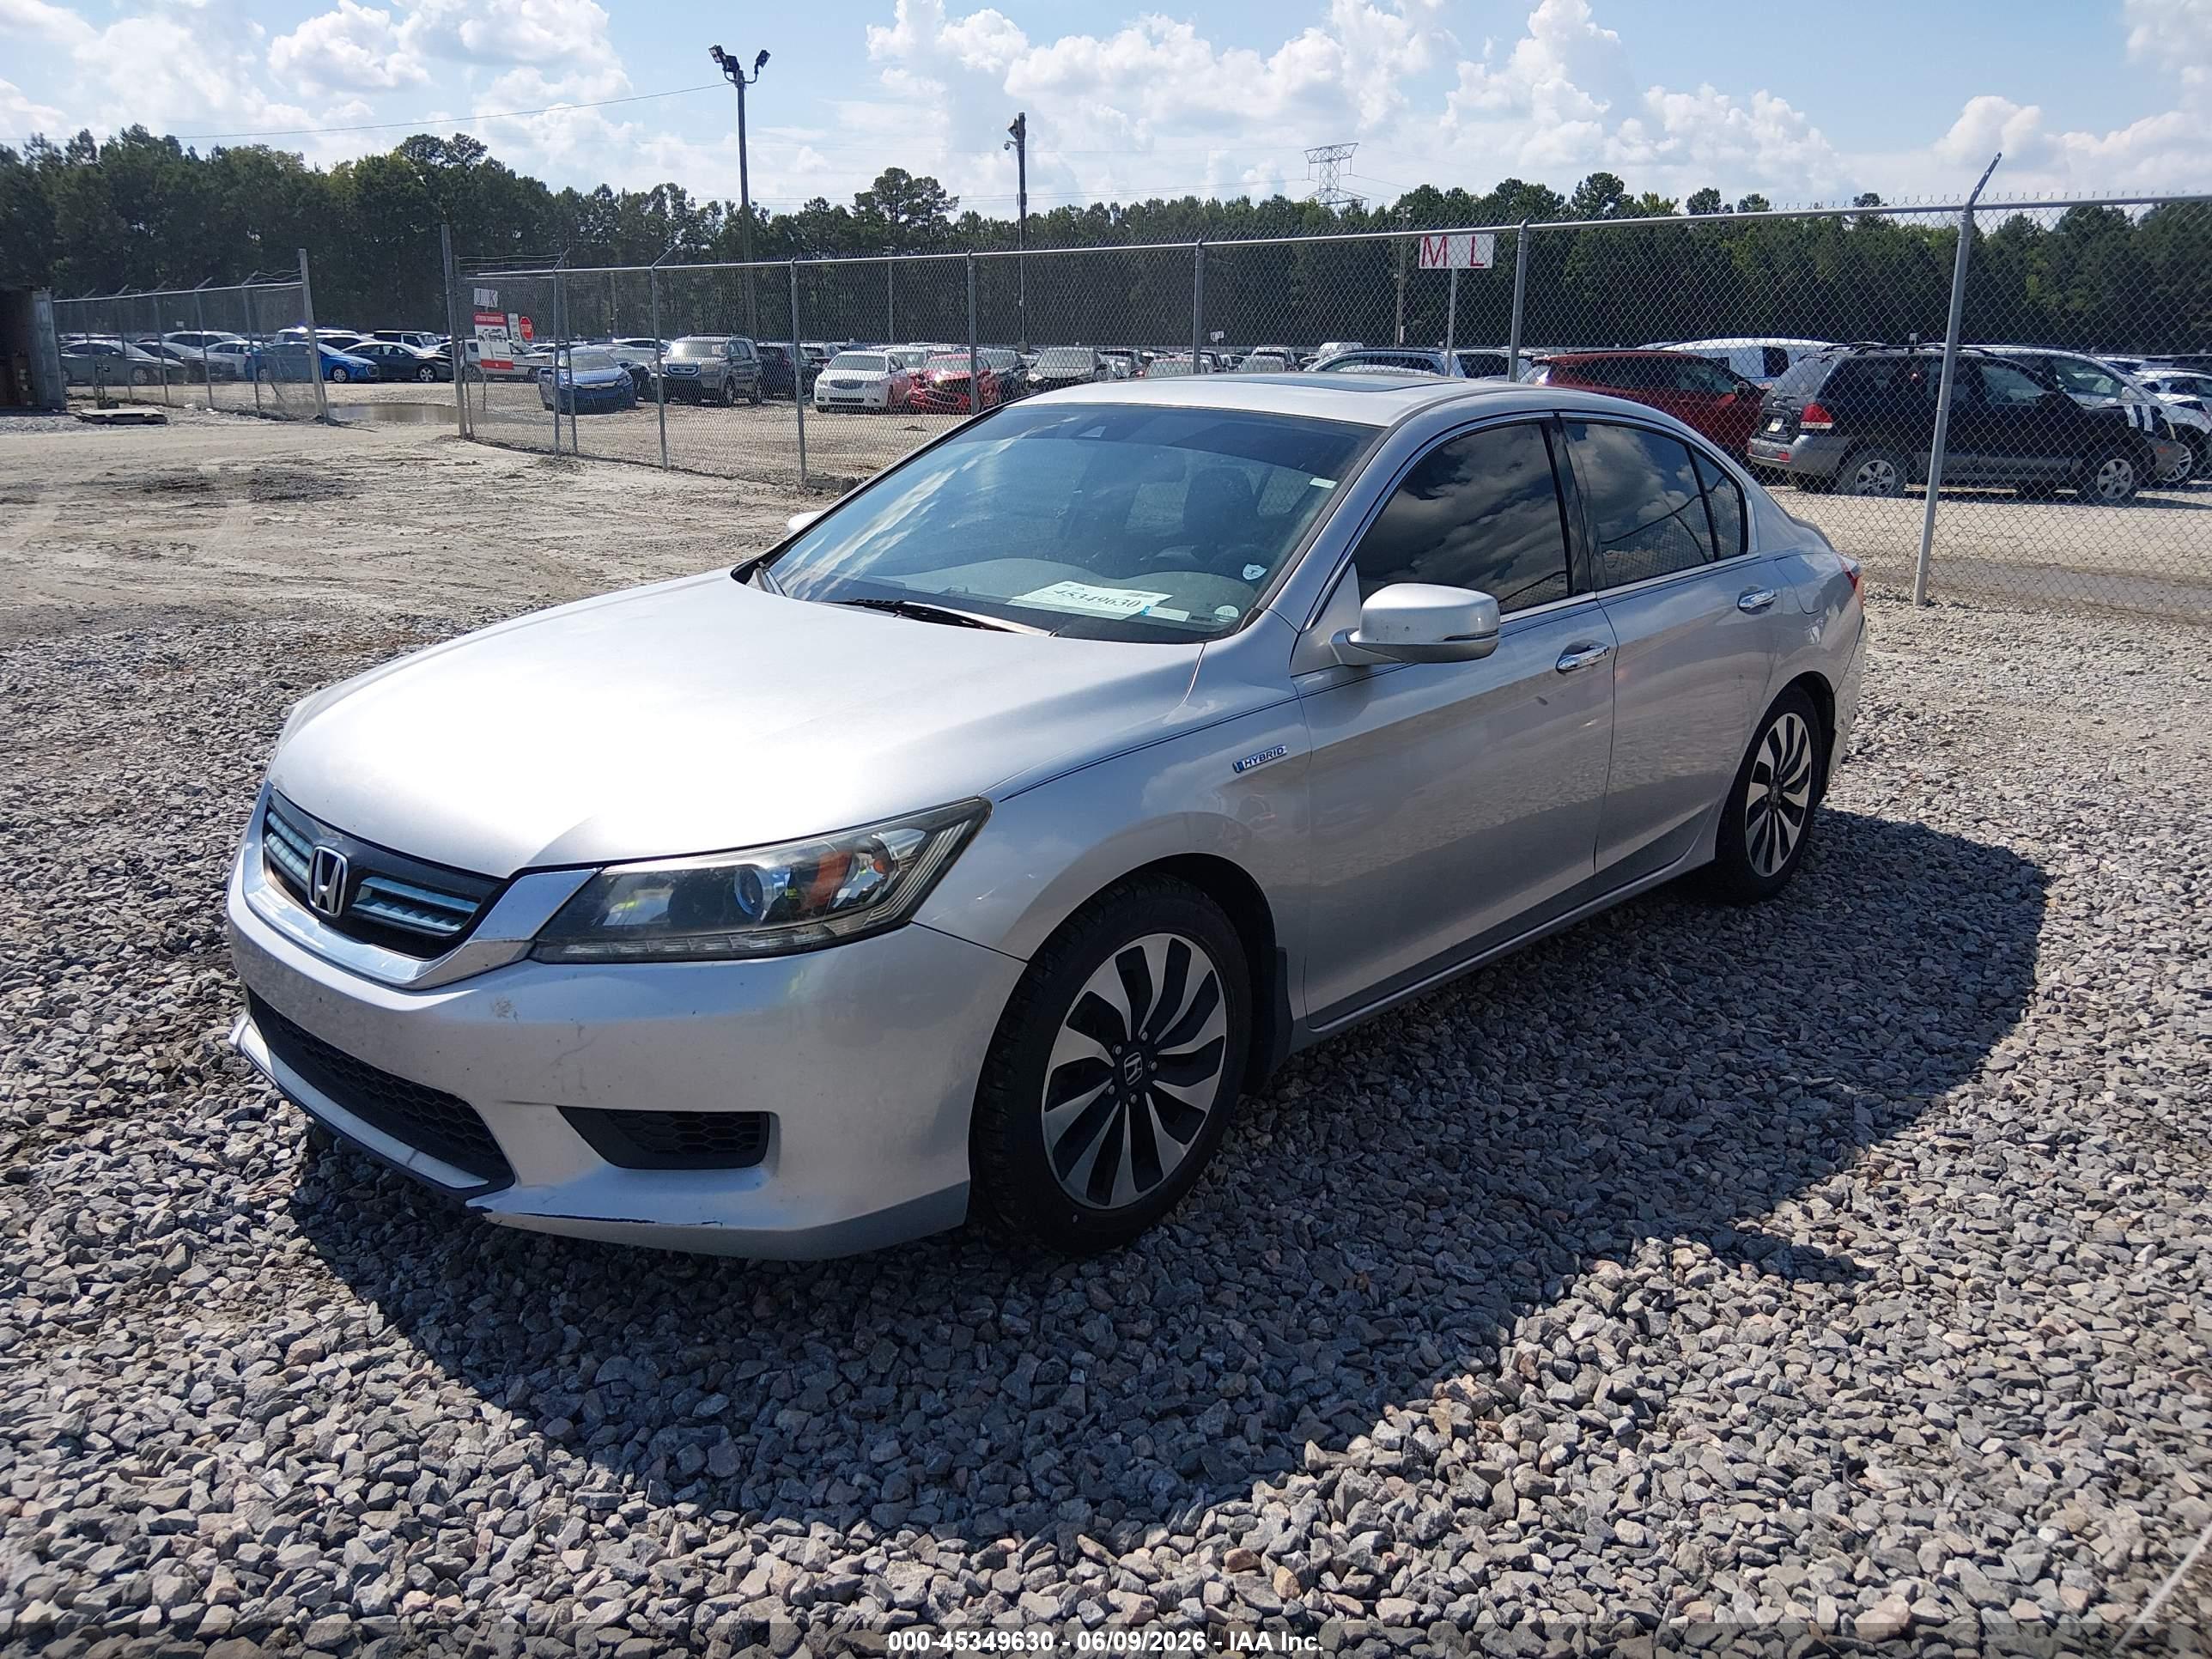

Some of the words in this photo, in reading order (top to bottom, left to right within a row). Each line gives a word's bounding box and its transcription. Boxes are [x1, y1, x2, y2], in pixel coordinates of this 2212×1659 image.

[1420, 234, 1448, 267] M
[1469, 235, 1485, 267] L
[1054, 590, 1141, 608] 45349630
[1244, 747, 1285, 768] HYBRID
